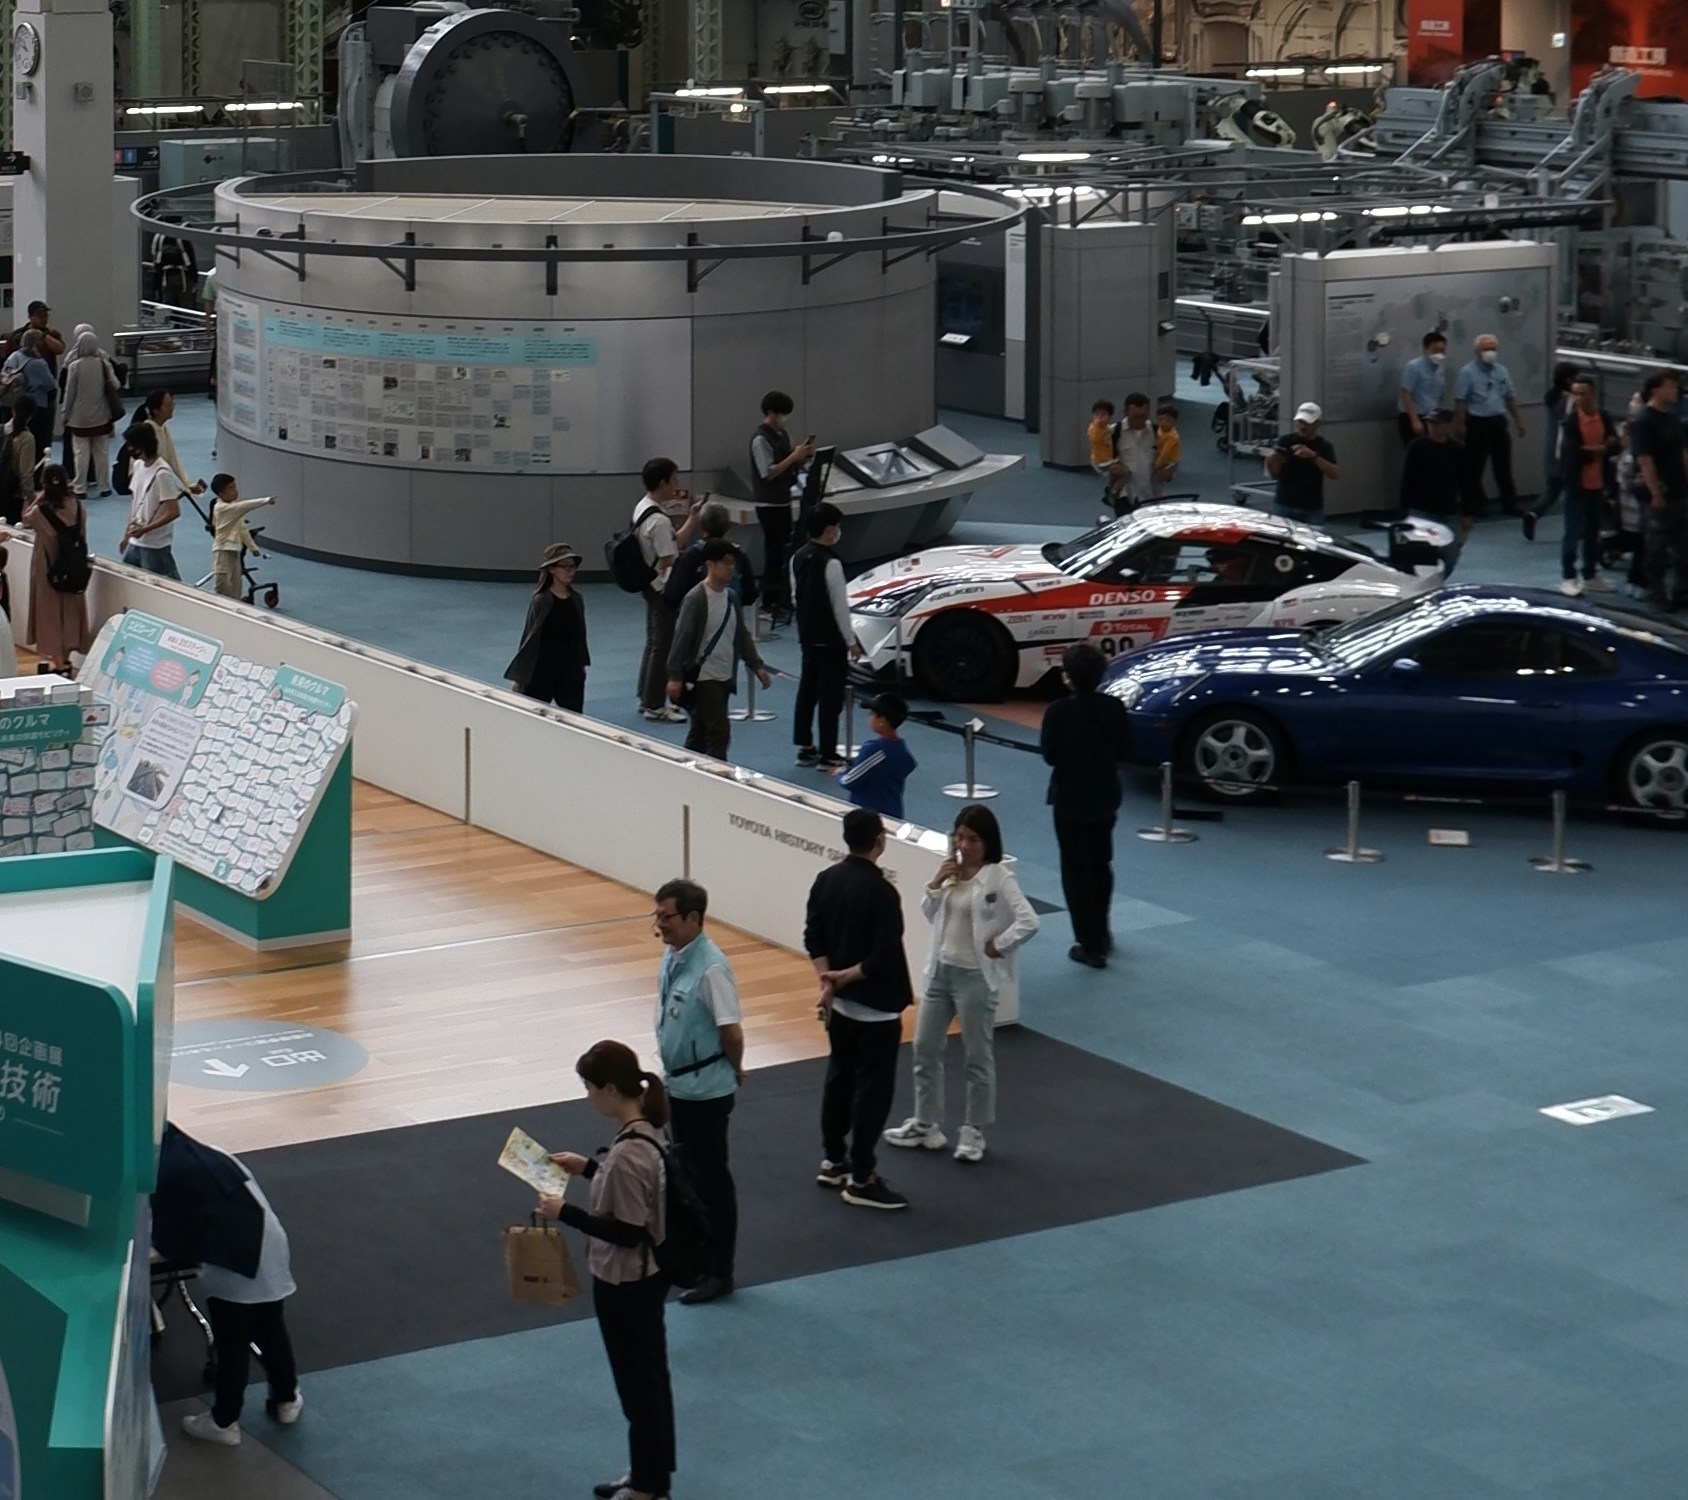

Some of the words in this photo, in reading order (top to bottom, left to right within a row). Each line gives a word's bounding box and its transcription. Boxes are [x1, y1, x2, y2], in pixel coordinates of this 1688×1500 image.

[1089, 589, 1156, 605] DENSO
[728, 812, 772, 839] TOYOTA
[774, 828, 826, 858] HISTORY
